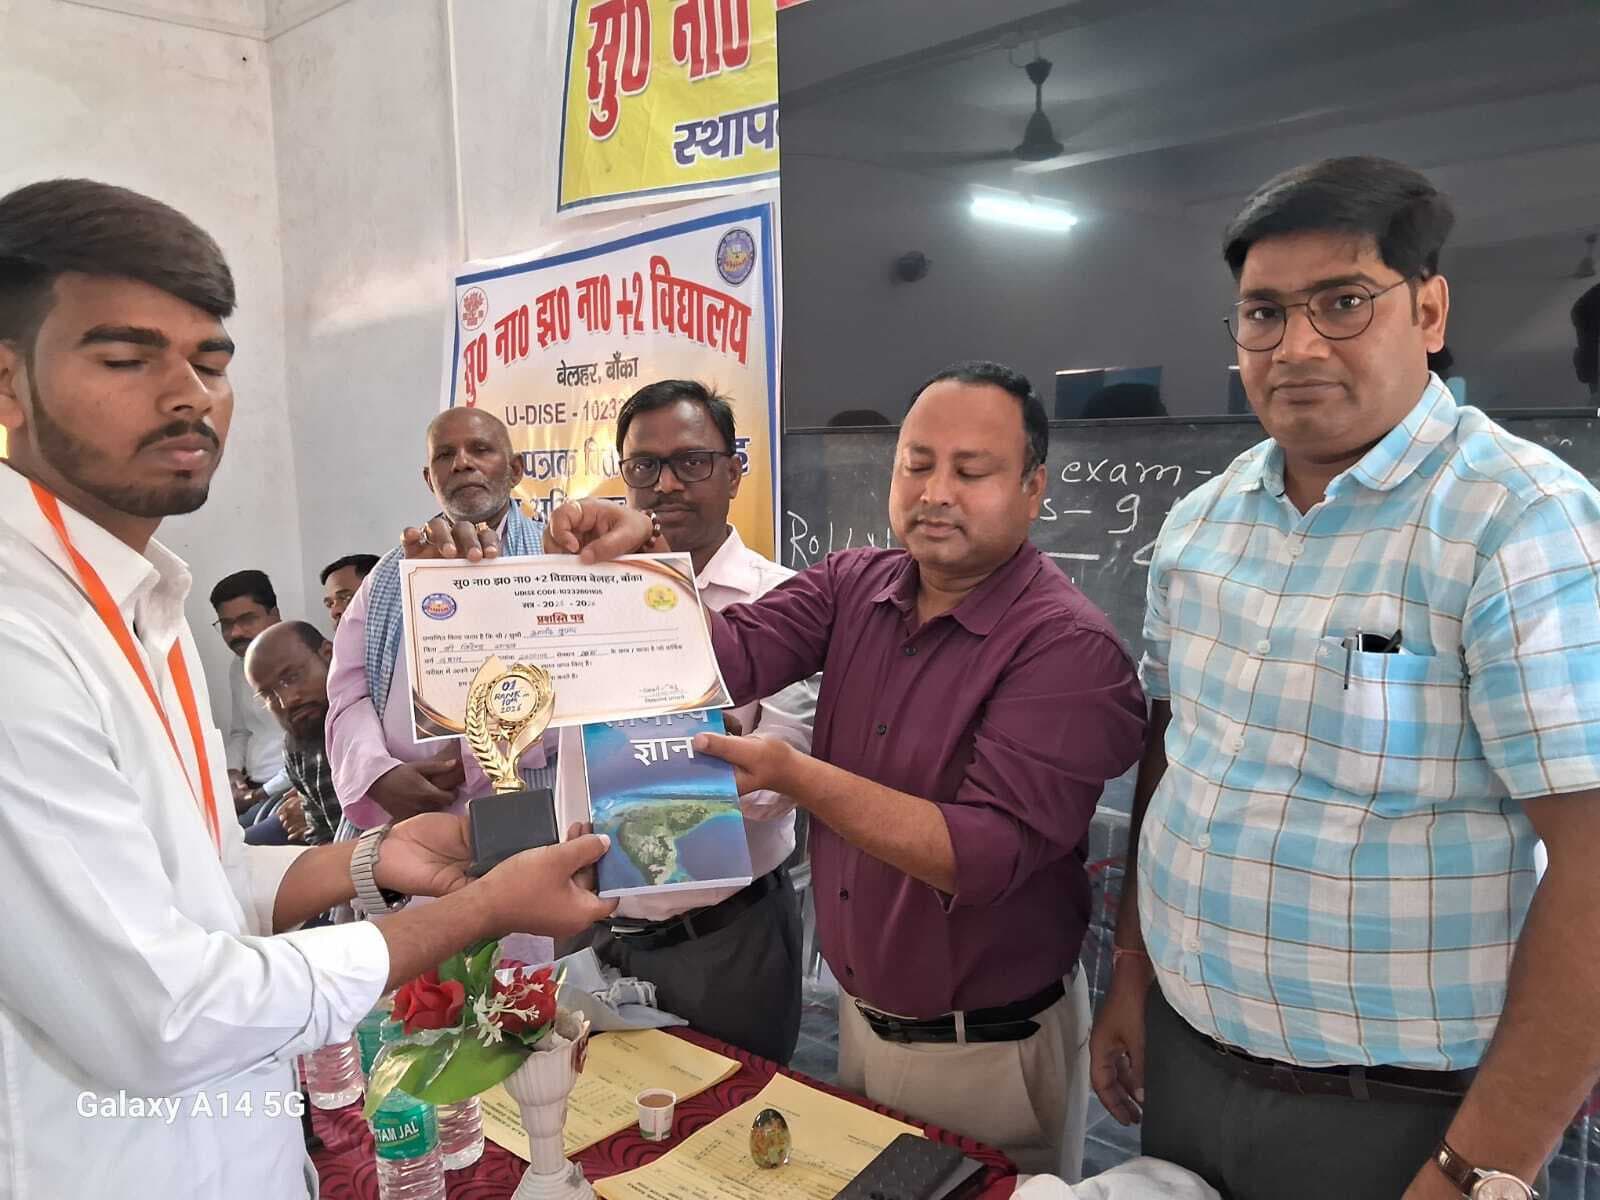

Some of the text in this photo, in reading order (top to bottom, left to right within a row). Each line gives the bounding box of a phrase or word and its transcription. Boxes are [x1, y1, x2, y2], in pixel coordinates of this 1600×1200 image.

[673, 102, 779, 166] स्थाप
[616, 271, 644, 335] +2
[649, 255, 753, 366] विद्यालय
[556, 351, 639, 386] बेलहर, बाँका
[505, 402, 566, 426] U-DISE
[583, 398, 626, 421] 1023
[1061, 459, 1182, 487] exam
[629, 735, 696, 767] ज्ञान
[400, 1120, 420, 1139] JAL
